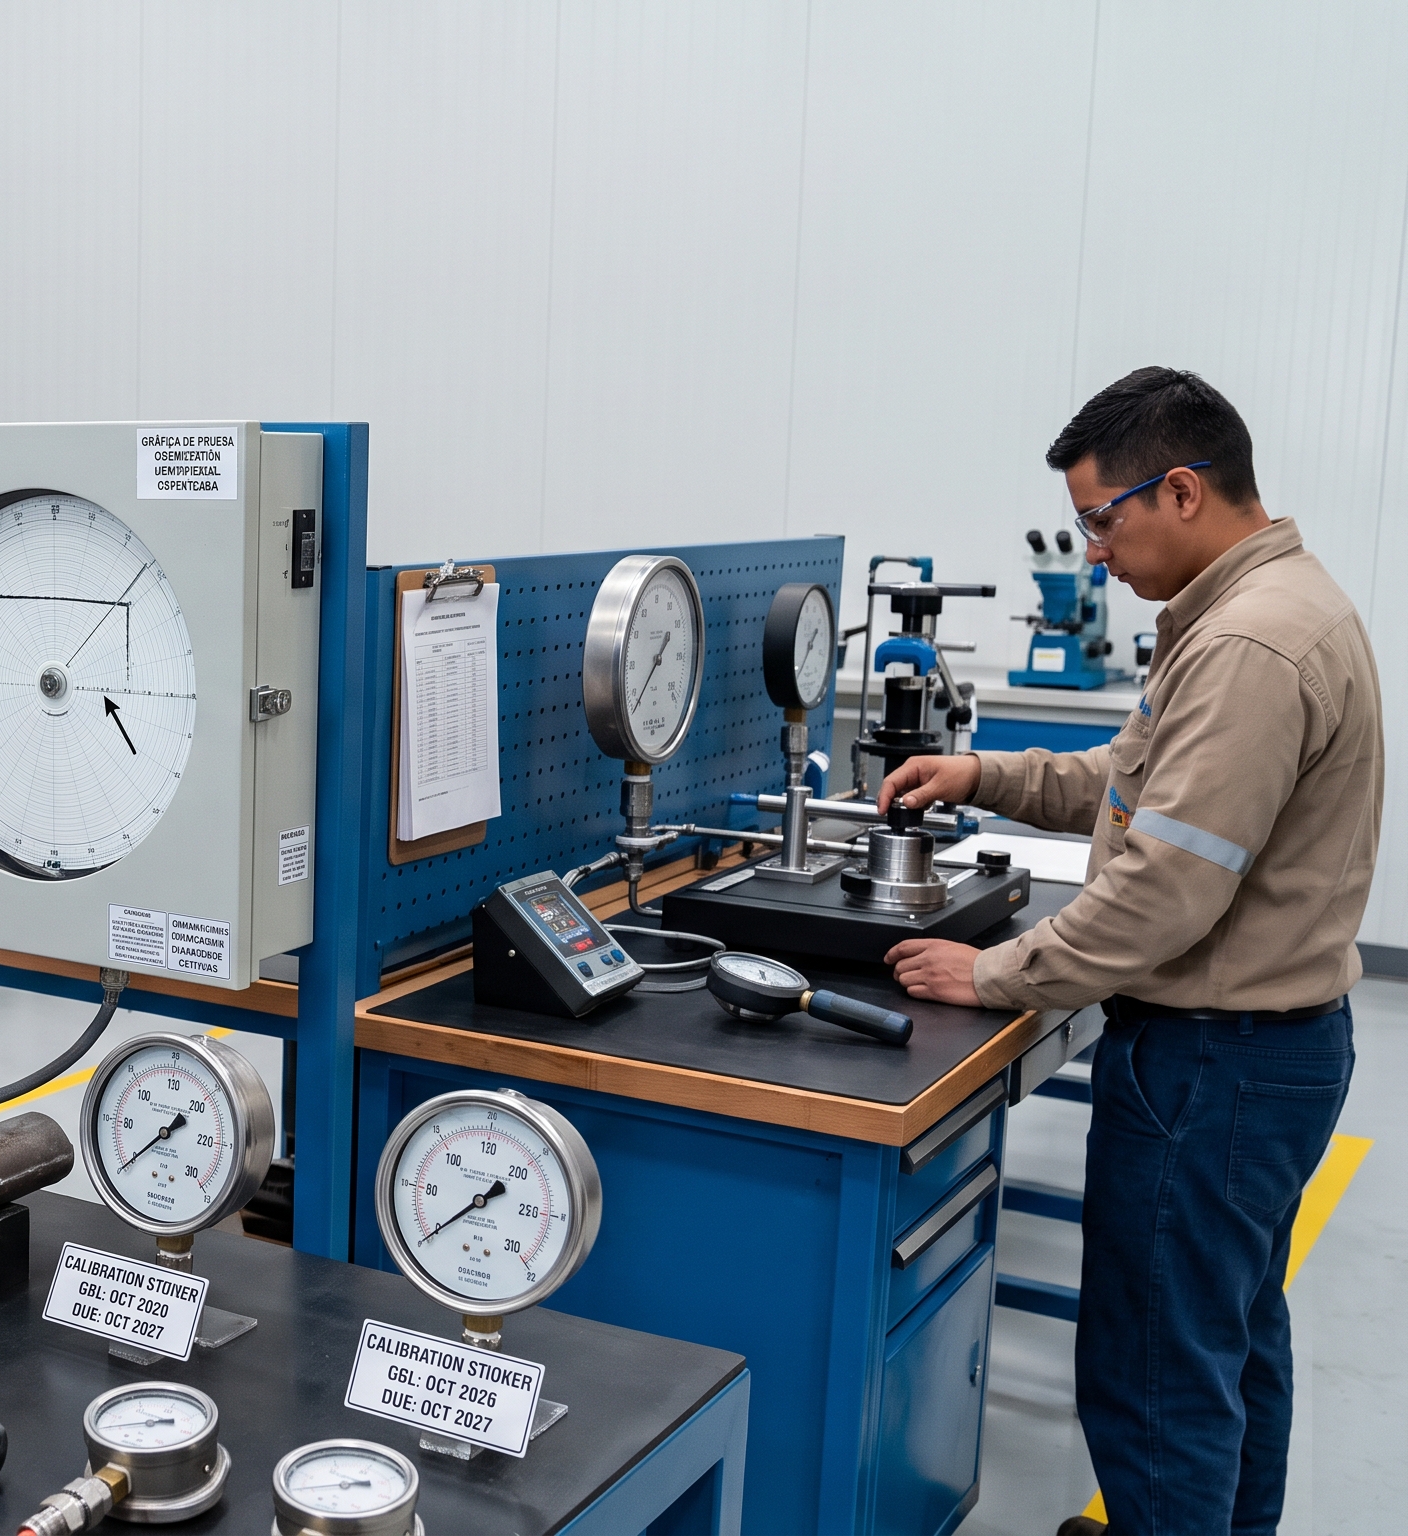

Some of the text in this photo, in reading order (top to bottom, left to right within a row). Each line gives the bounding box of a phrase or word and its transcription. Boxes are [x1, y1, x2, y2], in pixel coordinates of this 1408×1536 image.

[183, 437, 195, 446] DE
[198, 436, 234, 446] PRUESA
[138, 1090, 150, 1101] 100
[189, 1100, 205, 1113] 200
[197, 1134, 213, 1147] 220
[446, 1153, 461, 1166] 100
[508, 1165, 528, 1180] 200
[426, 1184, 437, 1196] 80
[504, 1238, 520, 1253] 310
[65, 1255, 145, 1288] CALIBRATION
[79, 1281, 168, 1318] GBL: OCT 2020
[72, 1303, 164, 1340] DUE: OCT 2027
[367, 1333, 465, 1373] CALIBRATION
[426, 1375, 456, 1396] OCT
[459, 1385, 497, 1408] 2026
[382, 1389, 493, 1433] DUE: OCT 2027
